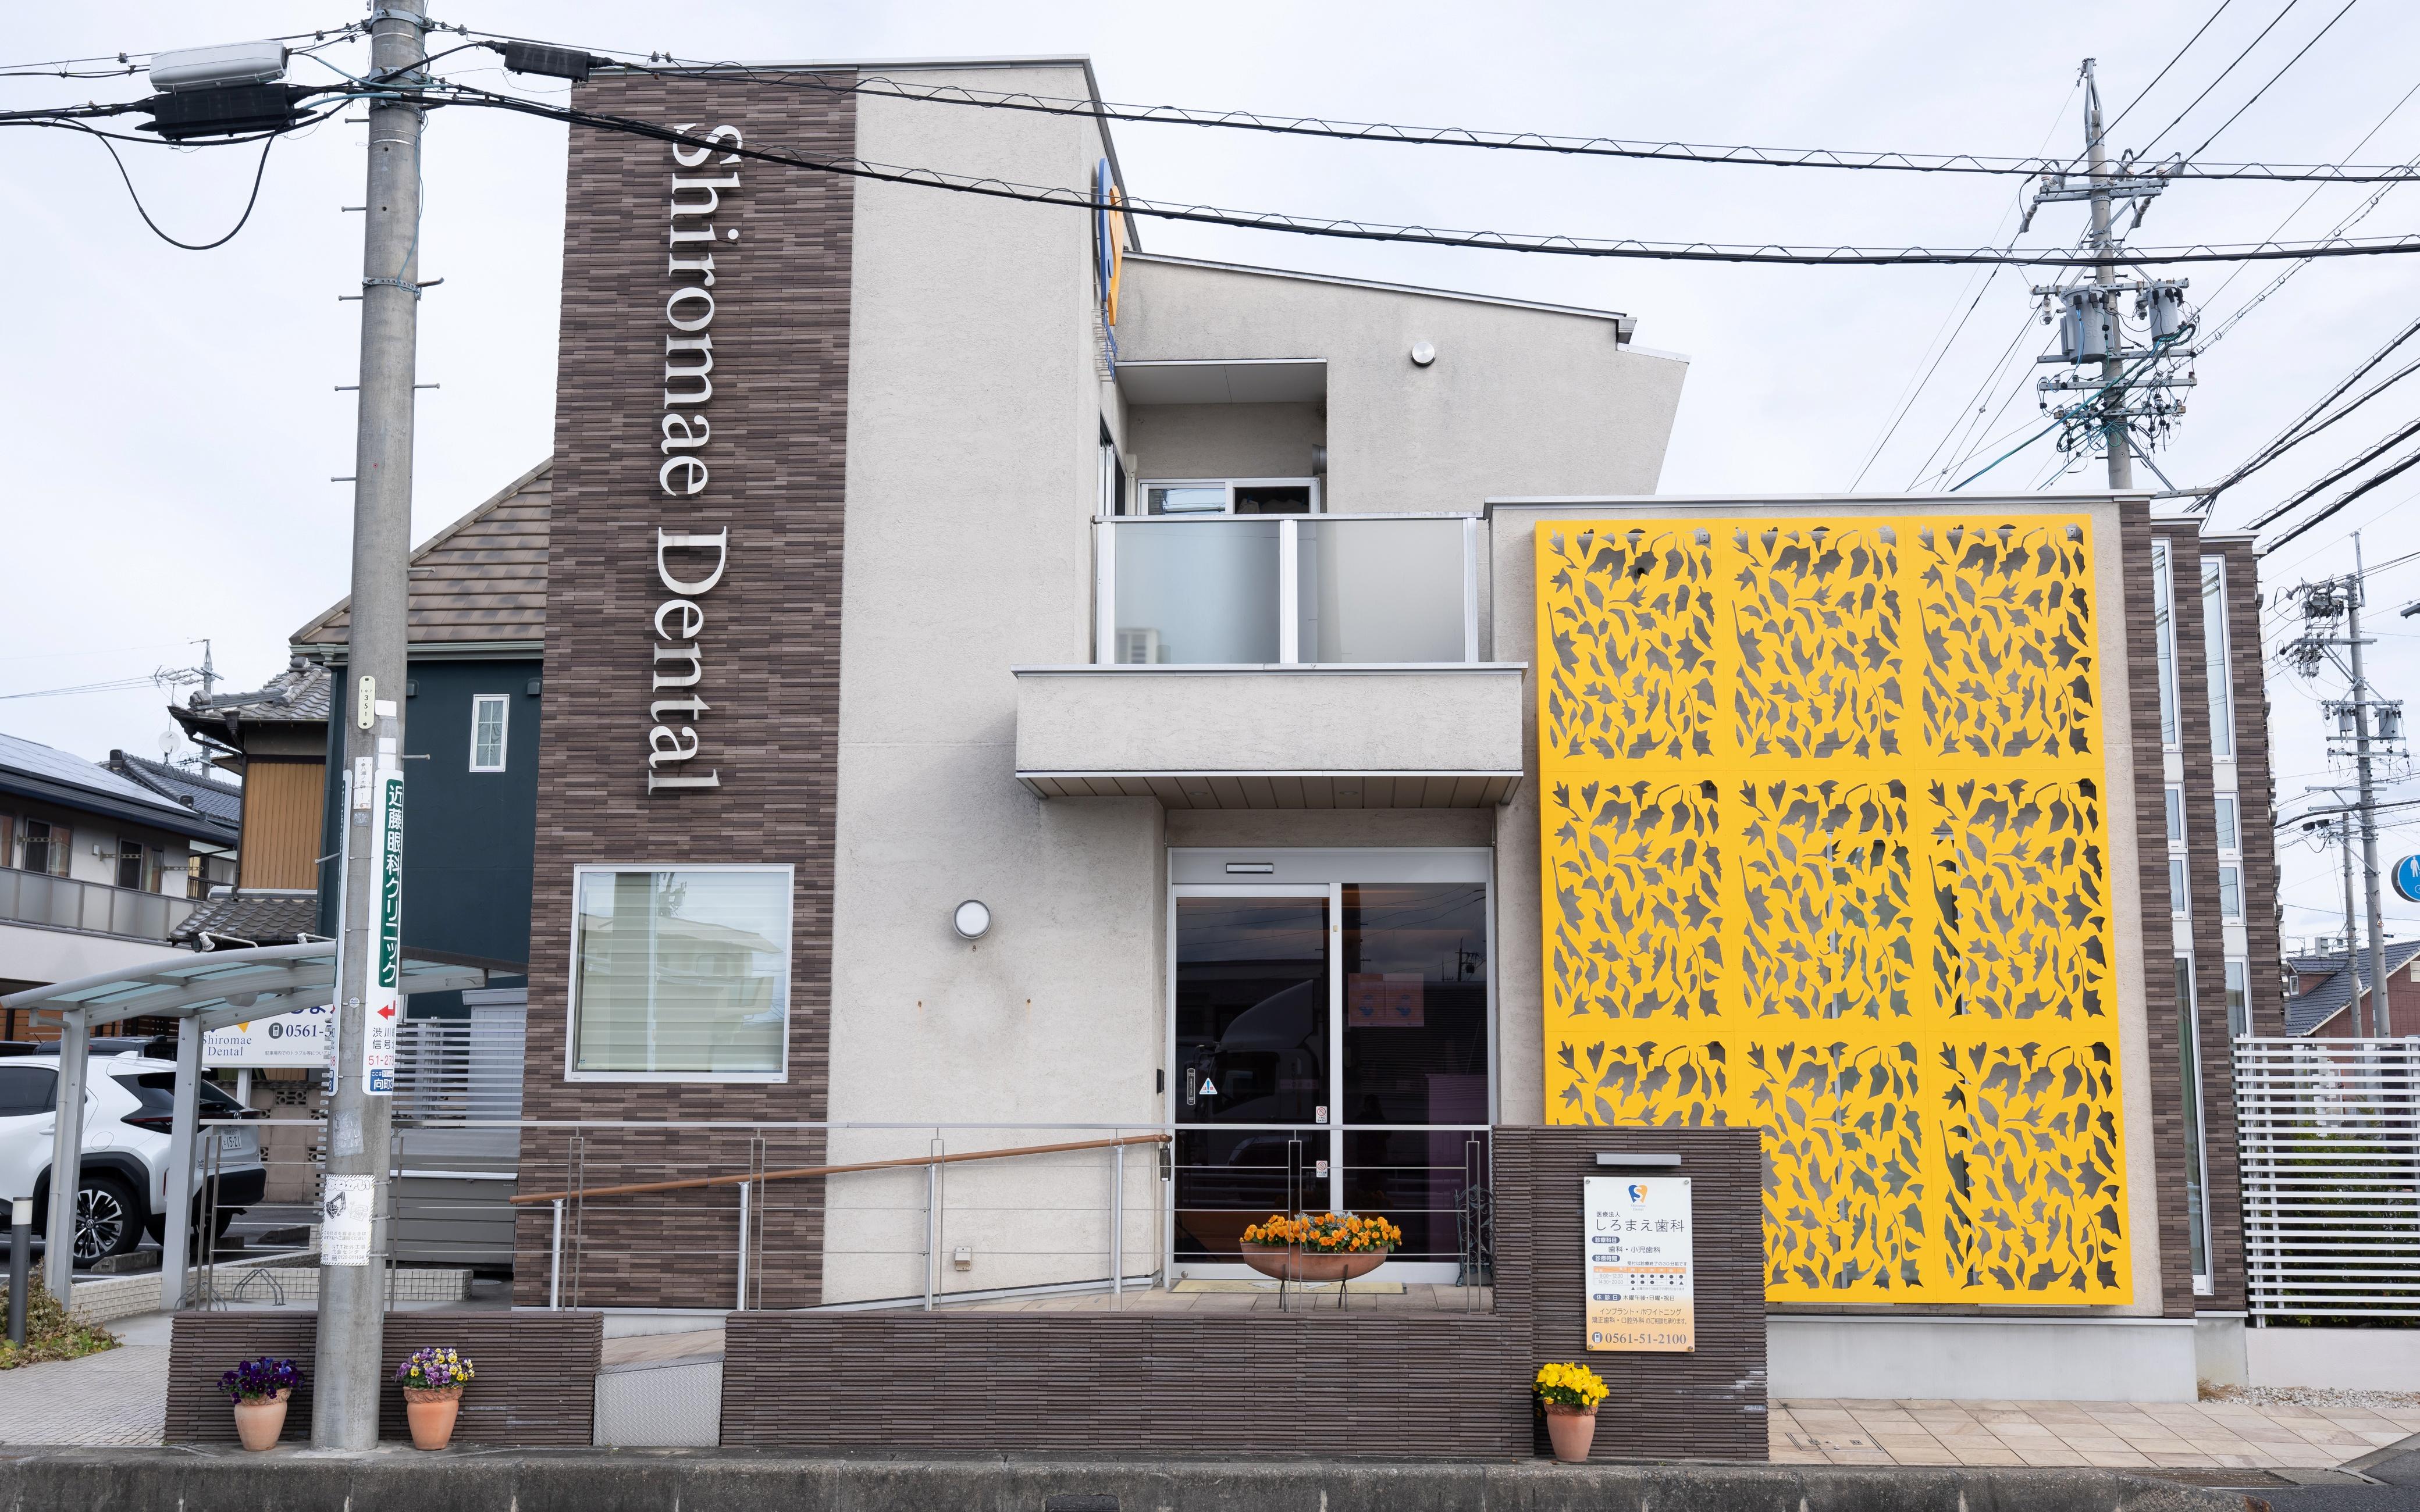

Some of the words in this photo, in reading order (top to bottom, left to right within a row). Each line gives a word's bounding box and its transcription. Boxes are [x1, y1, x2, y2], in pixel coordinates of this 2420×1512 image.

[660, 123, 743, 497] Shiromae
[649, 526, 728, 796] Dental
[383, 784, 403, 983] 近藤眼科クリニック
[203, 1035, 252, 1044] Shiromae
[208, 1046, 243, 1056] Dental
[1596, 1219, 1685, 1232] しろまえ歯科
[1599, 1308, 1681, 1316] インプラント・ホワイトニング
[1605, 1332, 1687, 1345] 0561-51-2100
